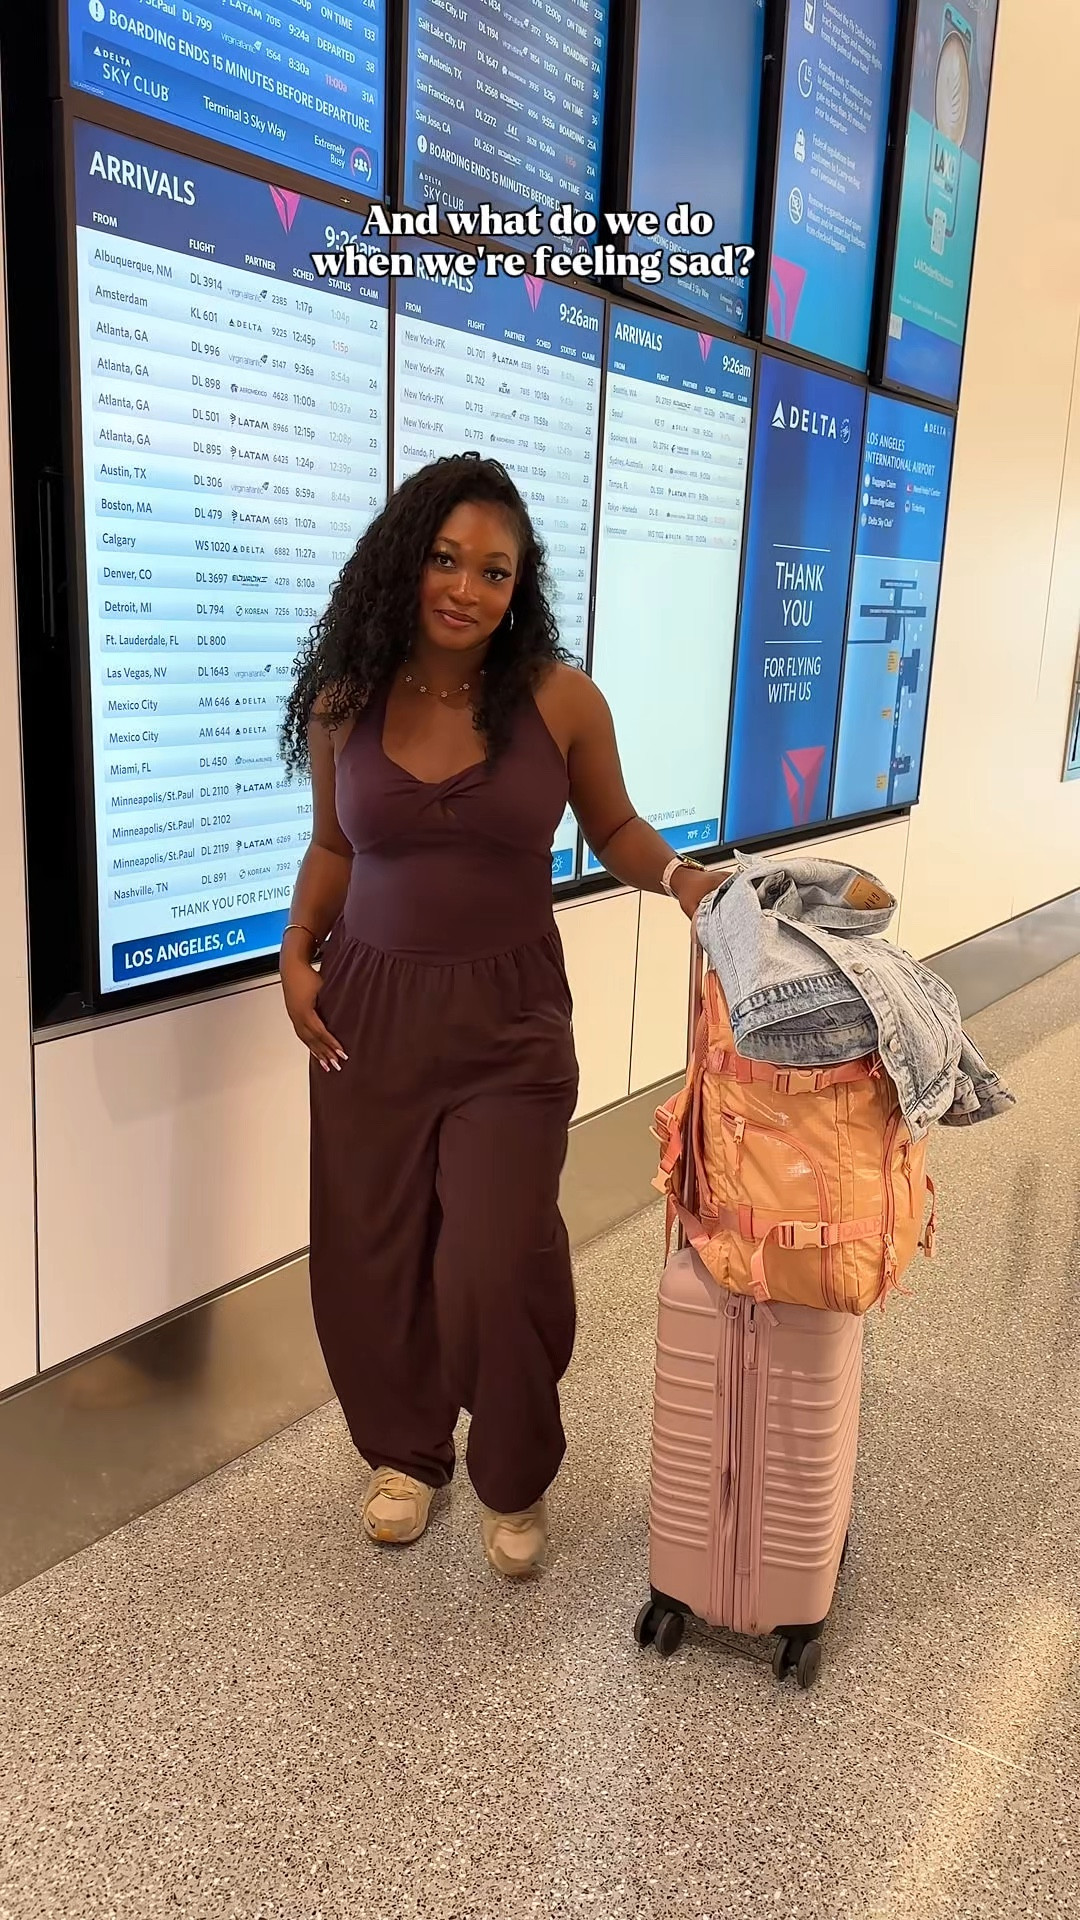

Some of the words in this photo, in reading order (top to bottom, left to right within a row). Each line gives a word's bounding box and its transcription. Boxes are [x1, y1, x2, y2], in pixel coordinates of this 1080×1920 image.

[230, 0, 262, 19] LATAM
[266, 14, 281, 28] 7015
[289, 24, 310, 42] 9:24a
[317, 37, 355, 63] DEPARTED
[366, 61, 375, 72] 38
[320, 7, 332, 20] ON
[334, 12, 353, 30] TIME
[364, 28, 375, 41] 133
[418, 18, 431, 33] Salt
[182, 9, 194, 25] DL
[196, 15, 212, 32] 799
[266, 48, 281, 62] 1564
[289, 57, 310, 75] 8:30a
[103, 50, 131, 67] DELTA
[417, 48, 428, 62] San
[430, 53, 452, 74] Antonio,
[454, 67, 462, 80] TX
[103, 63, 130, 86] SKY
[134, 76, 169, 101] CLUB
[109, 9, 175, 50] BOARDING
[179, 39, 210, 65] ENDS
[212, 55, 223, 70] 15
[226, 60, 274, 92] MINUTES
[277, 81, 314, 109] BEFORE
[316, 99, 372, 133] DEPARTURE.
[416, 79, 427, 93] San
[428, 83, 455, 107] Francisco,
[456, 98, 464, 111] CA
[203, 96, 242, 124] Terminal
[243, 112, 250, 124] 3
[250, 115, 266, 134] Sky
[267, 120, 286, 140] Way
[415, 110, 426, 123] San
[442, 122, 451, 134] CA
[314, 135, 345, 156] Extremely
[330, 156, 345, 168] Busy
[89, 151, 196, 205] ARRIVALS
[430, 143, 470, 172] BOARDING
[471, 162, 490, 179] ENDS
[491, 171, 498, 184] 15
[499, 174, 530, 198] MINUTES
[531, 189, 554, 208] BEFORE
[424, 186, 440, 201] SKY
[442, 193, 464, 211] CLUB
[93, 212, 117, 227] FROM
[190, 239, 215, 254] FLIGHT
[245, 255, 276, 271] PARTNER
[293, 268, 314, 281] SCHED
[328, 278, 351, 291] STATUS
[360, 287, 378, 299] CLAIM
[95, 249, 154, 275] Albuquerque,
[157, 264, 172, 278] NM
[203, 276, 222, 290] 3914
[96, 285, 148, 307] Amsterdam
[405, 302, 421, 314] FROM
[468, 320, 485, 331] FLIGHT
[504, 330, 526, 342] PARTNER
[559, 304, 598, 331] 9:26am
[97, 322, 132, 340] Atlanta,
[135, 330, 148, 342] GA
[615, 322, 662, 351] ARRIVALS
[97, 358, 132, 375] Atlanta,
[135, 365, 149, 376] GA
[722, 356, 751, 378] 9:26am
[99, 393, 134, 410] Atlanta,
[136, 400, 150, 411] GA
[238, 418, 269, 430] LATAM
[790, 406, 836, 439] DELTA
[930, 424, 946, 435] DELTA
[100, 429, 134, 444] Atlanta,
[137, 434, 150, 446] GA
[239, 451, 269, 461] LATAM
[867, 432, 878, 445] LOS
[879, 435, 905, 452] ANGELES
[100, 464, 132, 479] Austin,
[134, 468, 146, 479] TX
[866, 452, 912, 472] INTERNATIONAL
[912, 461, 935, 476] AIRPORT
[102, 499, 134, 512] Boston,
[137, 502, 152, 513] MA
[240, 514, 270, 524] LATAM
[103, 533, 136, 548] Calgary
[195, 541, 209, 550] WS
[211, 542, 230, 552] 1020
[104, 567, 136, 580] Denver,
[139, 569, 152, 579] CO
[209, 573, 227, 583] 3697
[776, 562, 824, 591] THANK
[105, 601, 138, 613] Detroit,
[140, 602, 151, 612] MI
[783, 600, 812, 626] YOU
[106, 635, 116, 645] Ft.
[119, 635, 167, 646] Lauderdale,
[170, 636, 179, 645] FL
[107, 668, 121, 678] Las
[124, 668, 151, 679] Vegas,
[154, 667, 166, 677] NV
[211, 667, 229, 676] 1643
[764, 658, 784, 678] FOR
[787, 656, 821, 676] FLYING
[109, 700, 139, 711] Mexico
[142, 700, 158, 711] City
[199, 698, 212, 707] AM
[769, 683, 795, 703] WITH
[799, 682, 811, 700] US
[110, 732, 140, 743] Mexico
[142, 731, 158, 742] City
[111, 764, 139, 775] Miami,
[142, 763, 151, 772] FL
[111, 789, 194, 807] Minneapolis/St.Paul
[113, 819, 194, 838] Minneapolis/St.Paul
[113, 848, 195, 869] Minneapolis/St.Paul
[114, 886, 154, 900] Nashville,
[156, 882, 168, 893] TN
[171, 902, 209, 918] THANK
[213, 896, 234, 912] YOU
[237, 891, 257, 906] FOR
[258, 885, 290, 901] FLYING
[125, 949, 153, 969] LOS
[157, 934, 223, 962] ANGELES,
[227, 929, 245, 946] CA
